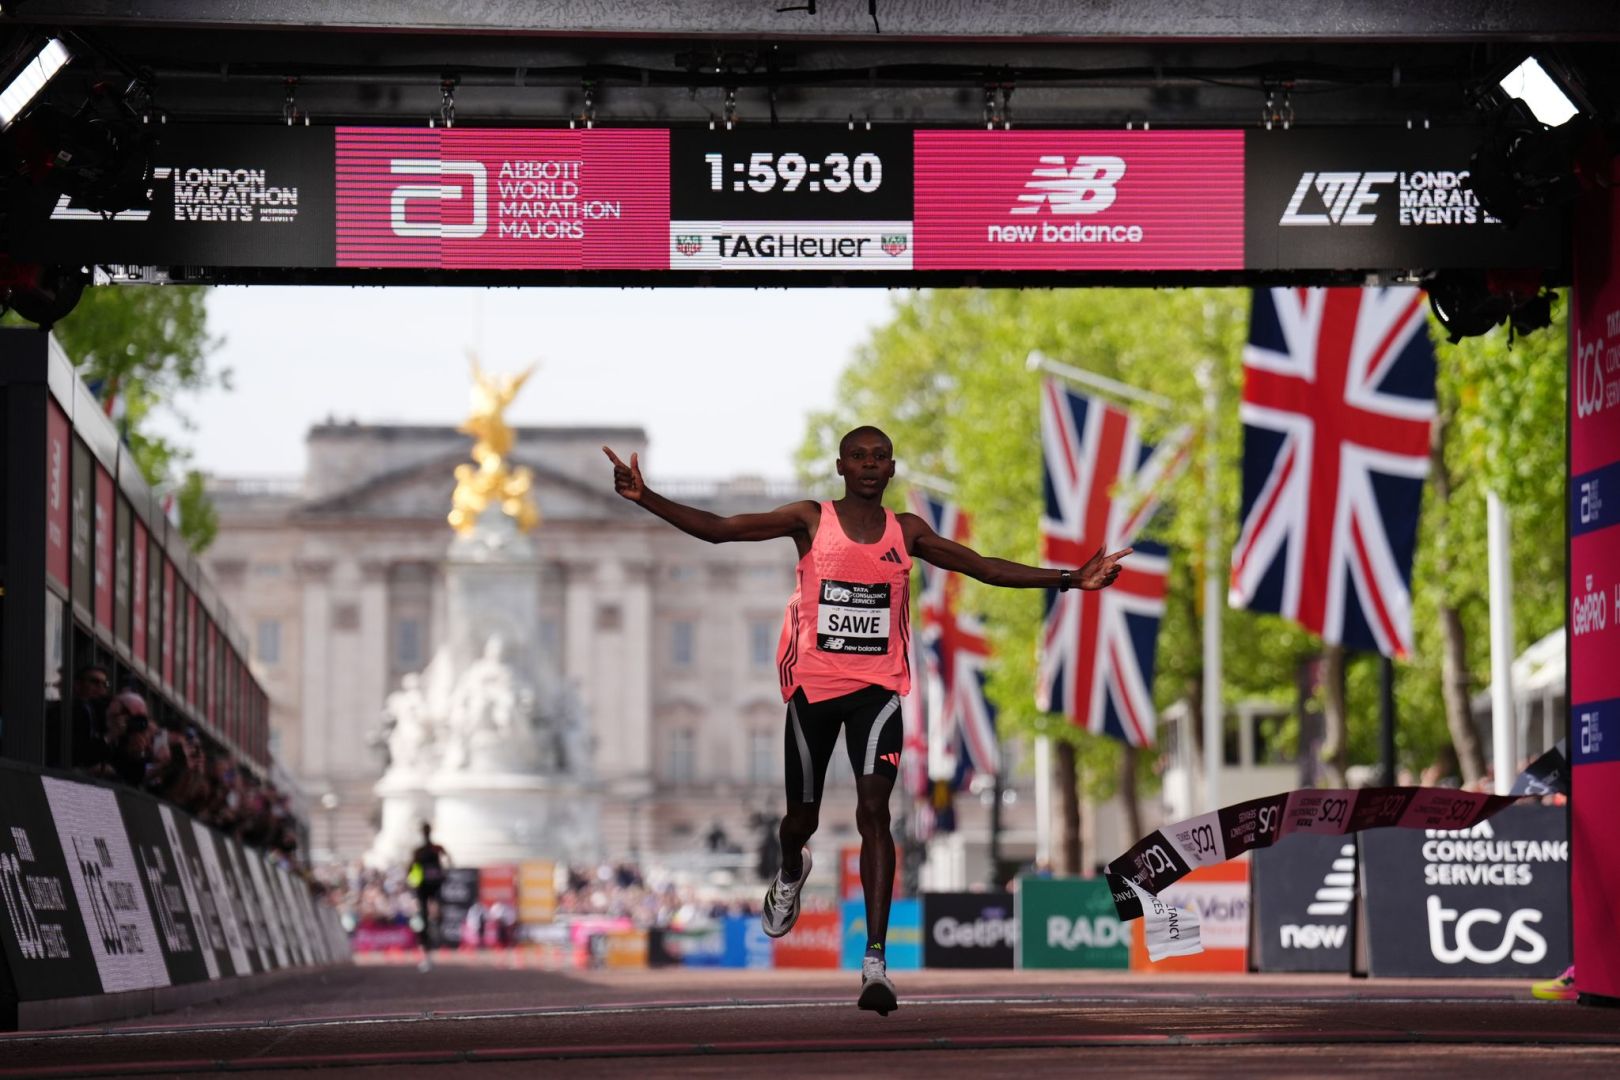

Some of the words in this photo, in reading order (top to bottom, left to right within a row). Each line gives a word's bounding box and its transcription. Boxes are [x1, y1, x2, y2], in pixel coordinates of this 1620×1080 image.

[174, 168, 265, 187] LONDON
[498, 160, 583, 179] ABBOTT
[705, 153, 882, 193] 1:59:30
[174, 186, 298, 205] MARATHON
[498, 180, 578, 200] WORLD
[174, 204, 253, 221] EVENTS
[498, 201, 621, 219] MARATHON
[1400, 207, 1477, 225] EVENTS
[498, 220, 584, 239] MAJORS
[988, 225, 1038, 242] new
[1042, 221, 1143, 243] balance
[1577, 328, 1604, 418] tcs
[824, 583, 851, 602] tcs
[1573, 590, 1607, 636] GetPRO
[828, 614, 881, 634] SAWE
[1318, 798, 1349, 829] tcs
[1191, 824, 1217, 857] tcs
[1142, 844, 1178, 878] tcs
[1424, 863, 1533, 886] SERVICES
[1279, 924, 1348, 949] new
[1427, 895, 1548, 964] tcs
